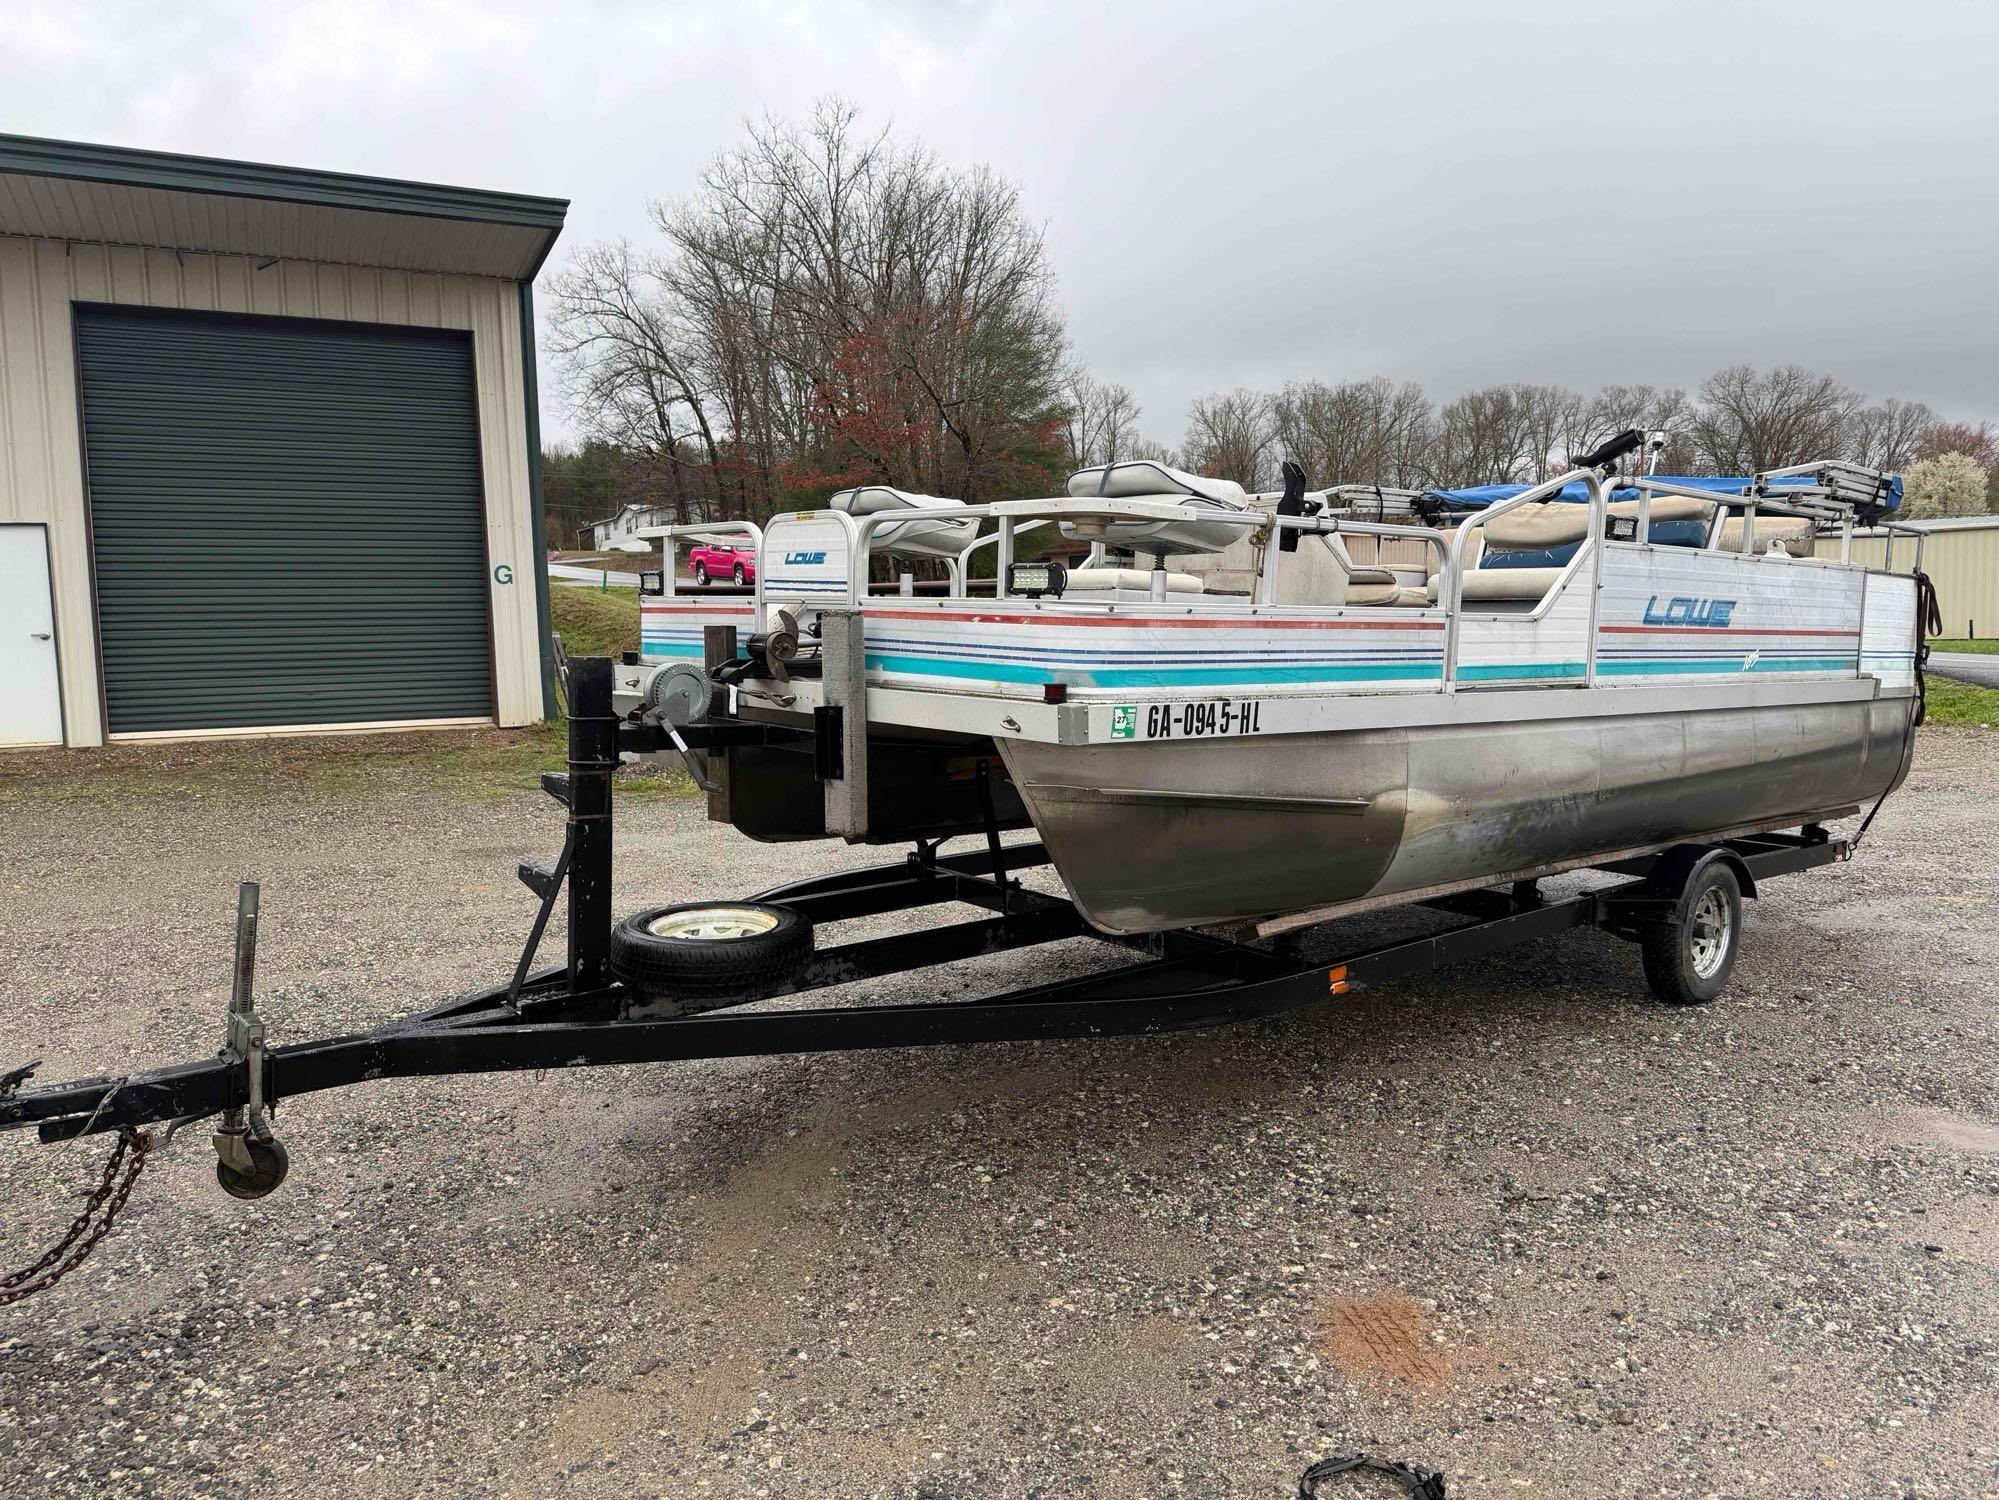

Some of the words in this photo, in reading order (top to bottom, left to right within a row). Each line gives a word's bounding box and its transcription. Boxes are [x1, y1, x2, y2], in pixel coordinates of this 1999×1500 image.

[785, 552, 827, 565] LOWE
[494, 565, 513, 584] G
[1643, 596, 1738, 628] LOWE
[1116, 716, 1127, 724] 27
